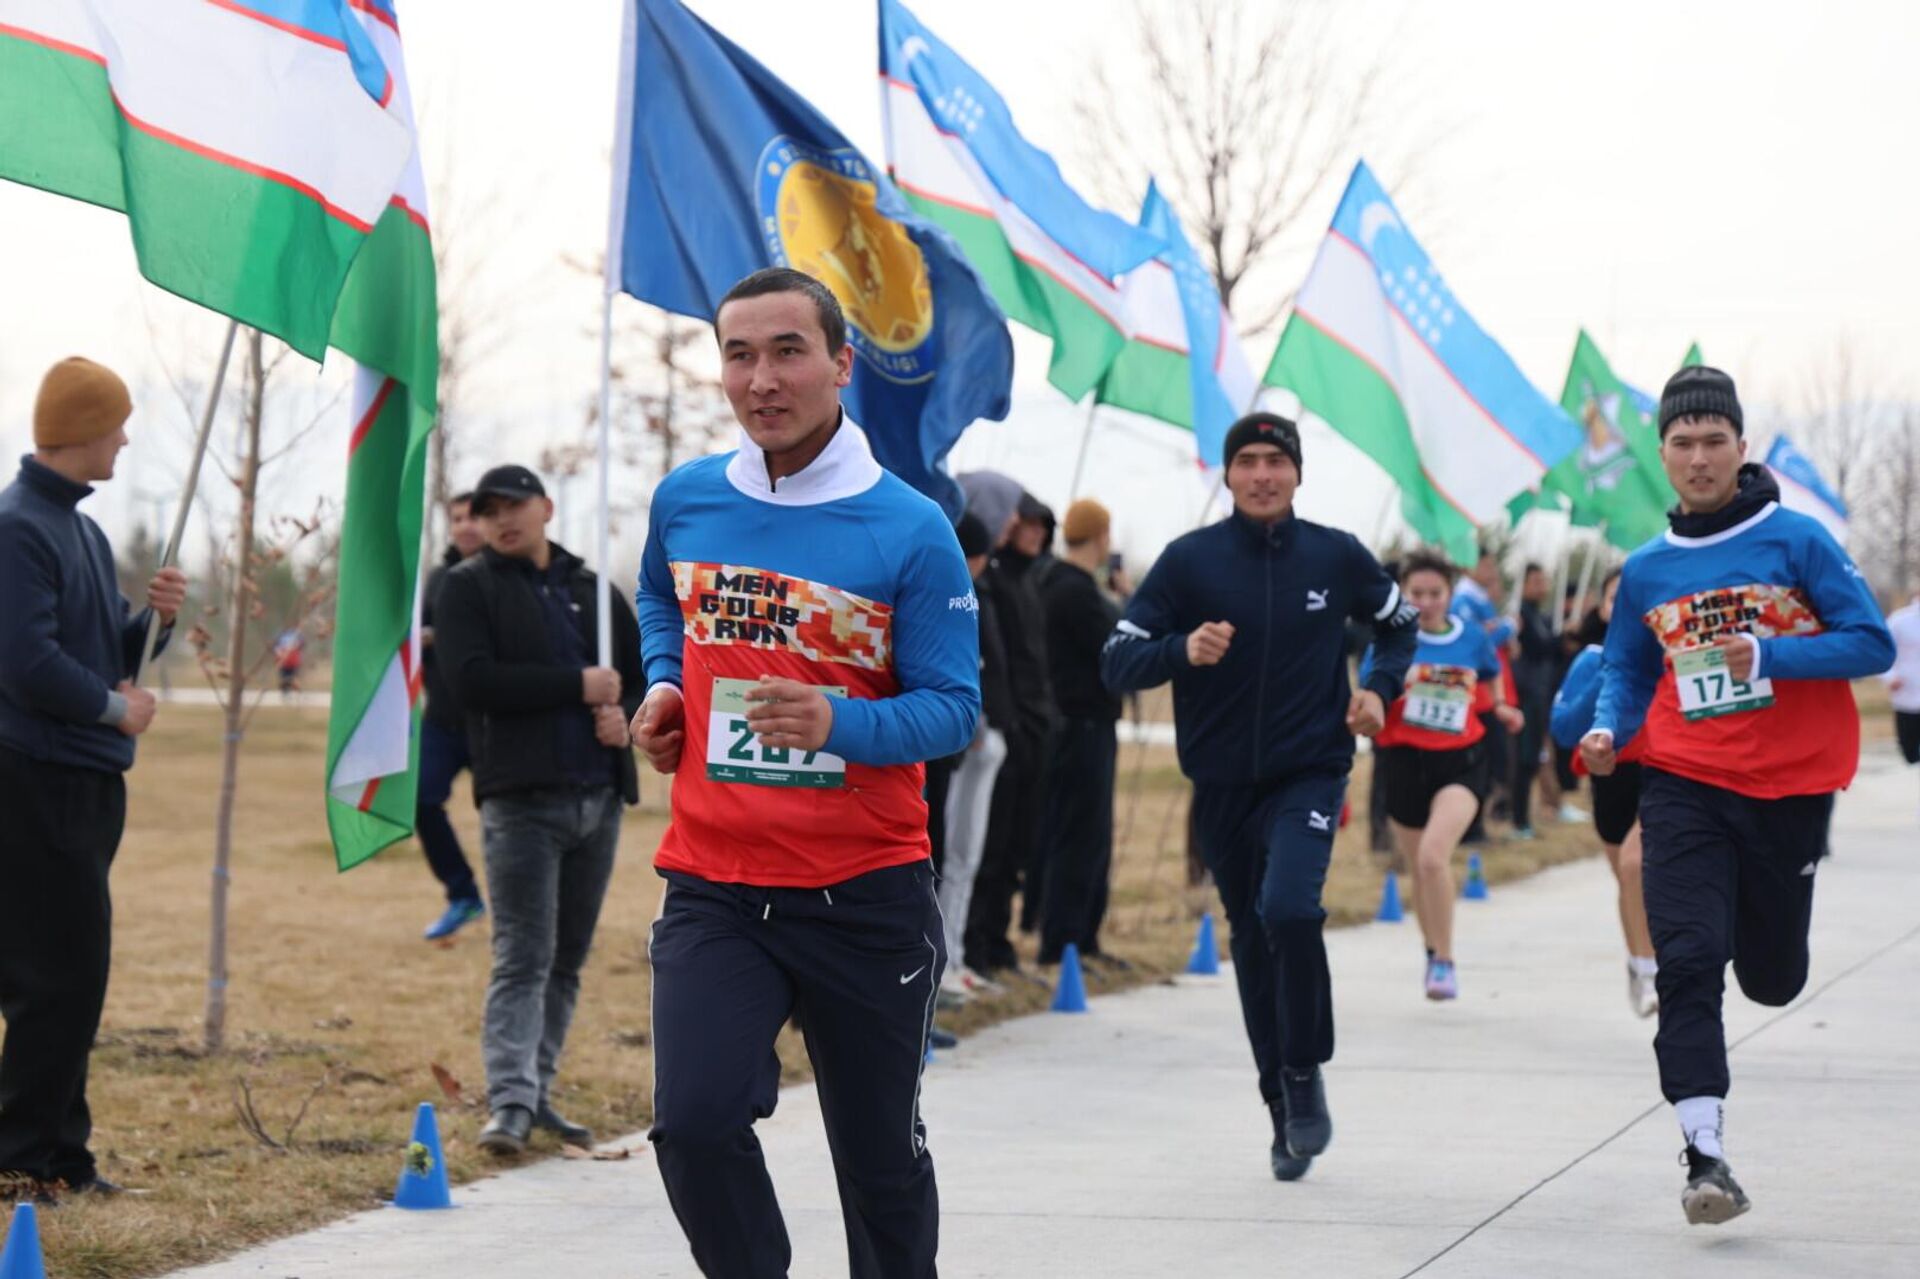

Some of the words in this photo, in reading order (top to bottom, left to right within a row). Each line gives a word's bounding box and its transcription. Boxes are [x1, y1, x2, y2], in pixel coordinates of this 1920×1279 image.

[715, 571, 788, 602] MEN
[1691, 592, 1744, 613] MEN
[715, 618, 788, 646] RUN
